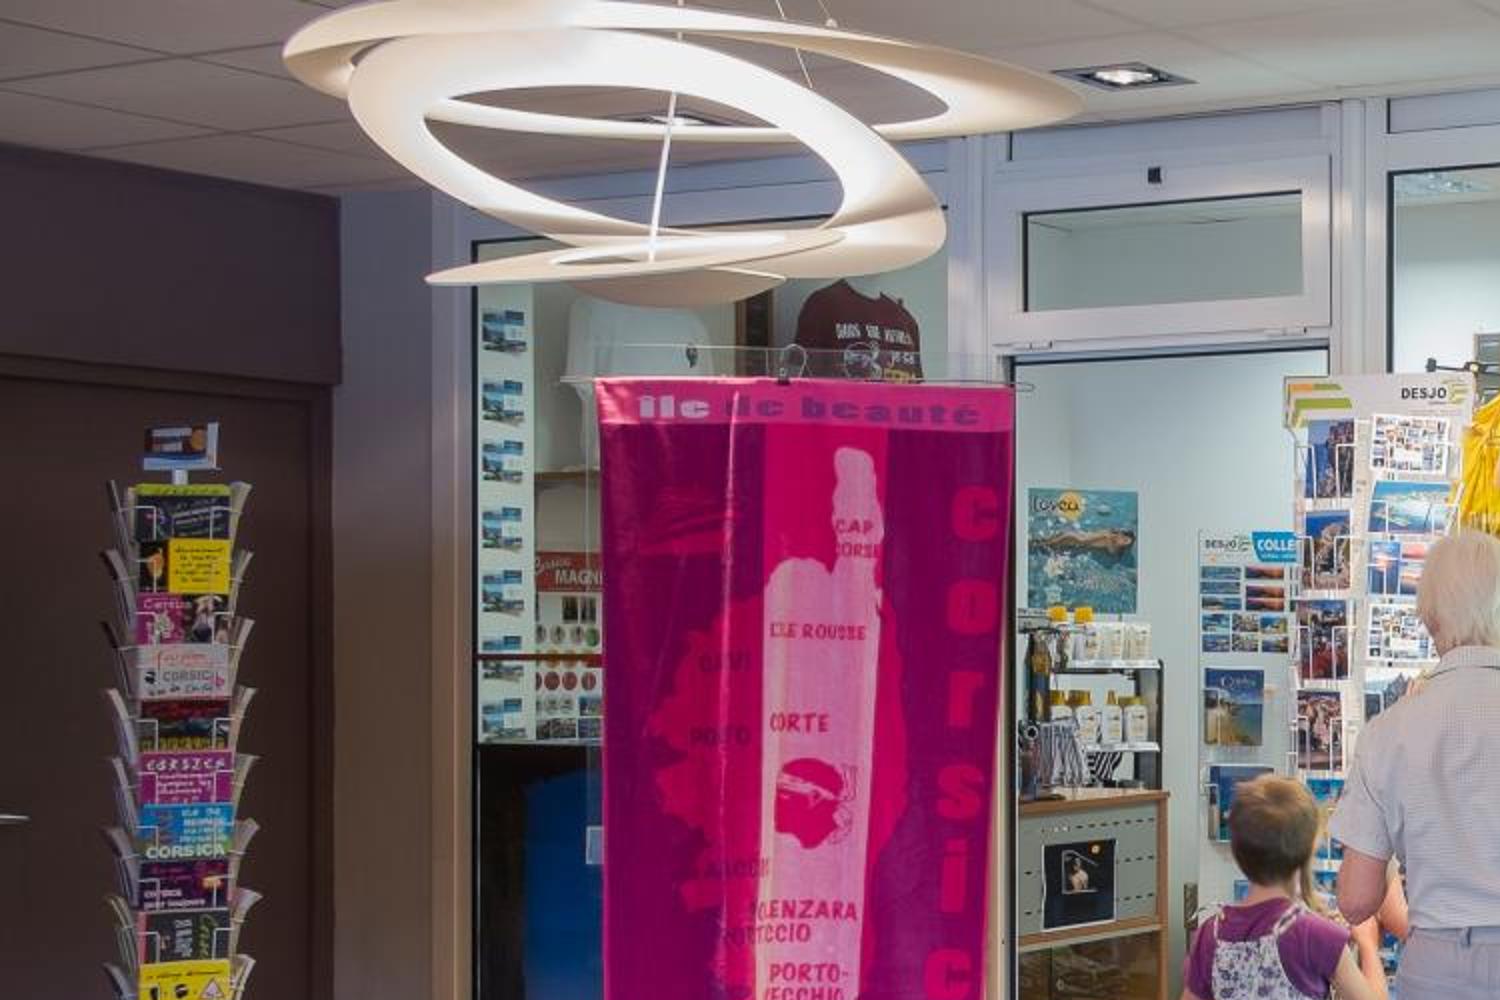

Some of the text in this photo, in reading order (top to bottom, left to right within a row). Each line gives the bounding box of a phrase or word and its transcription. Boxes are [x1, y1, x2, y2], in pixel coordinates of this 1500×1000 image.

[1401, 387, 1447, 399] DESJO
[801, 397, 980, 425] beauté
[836, 520, 872, 534] CAP
[801, 623, 866, 640] ROUSSE
[769, 711, 829, 733] CORTE
[146, 843, 225, 859] CORSICA
[768, 962, 848, 983] PORTO-
